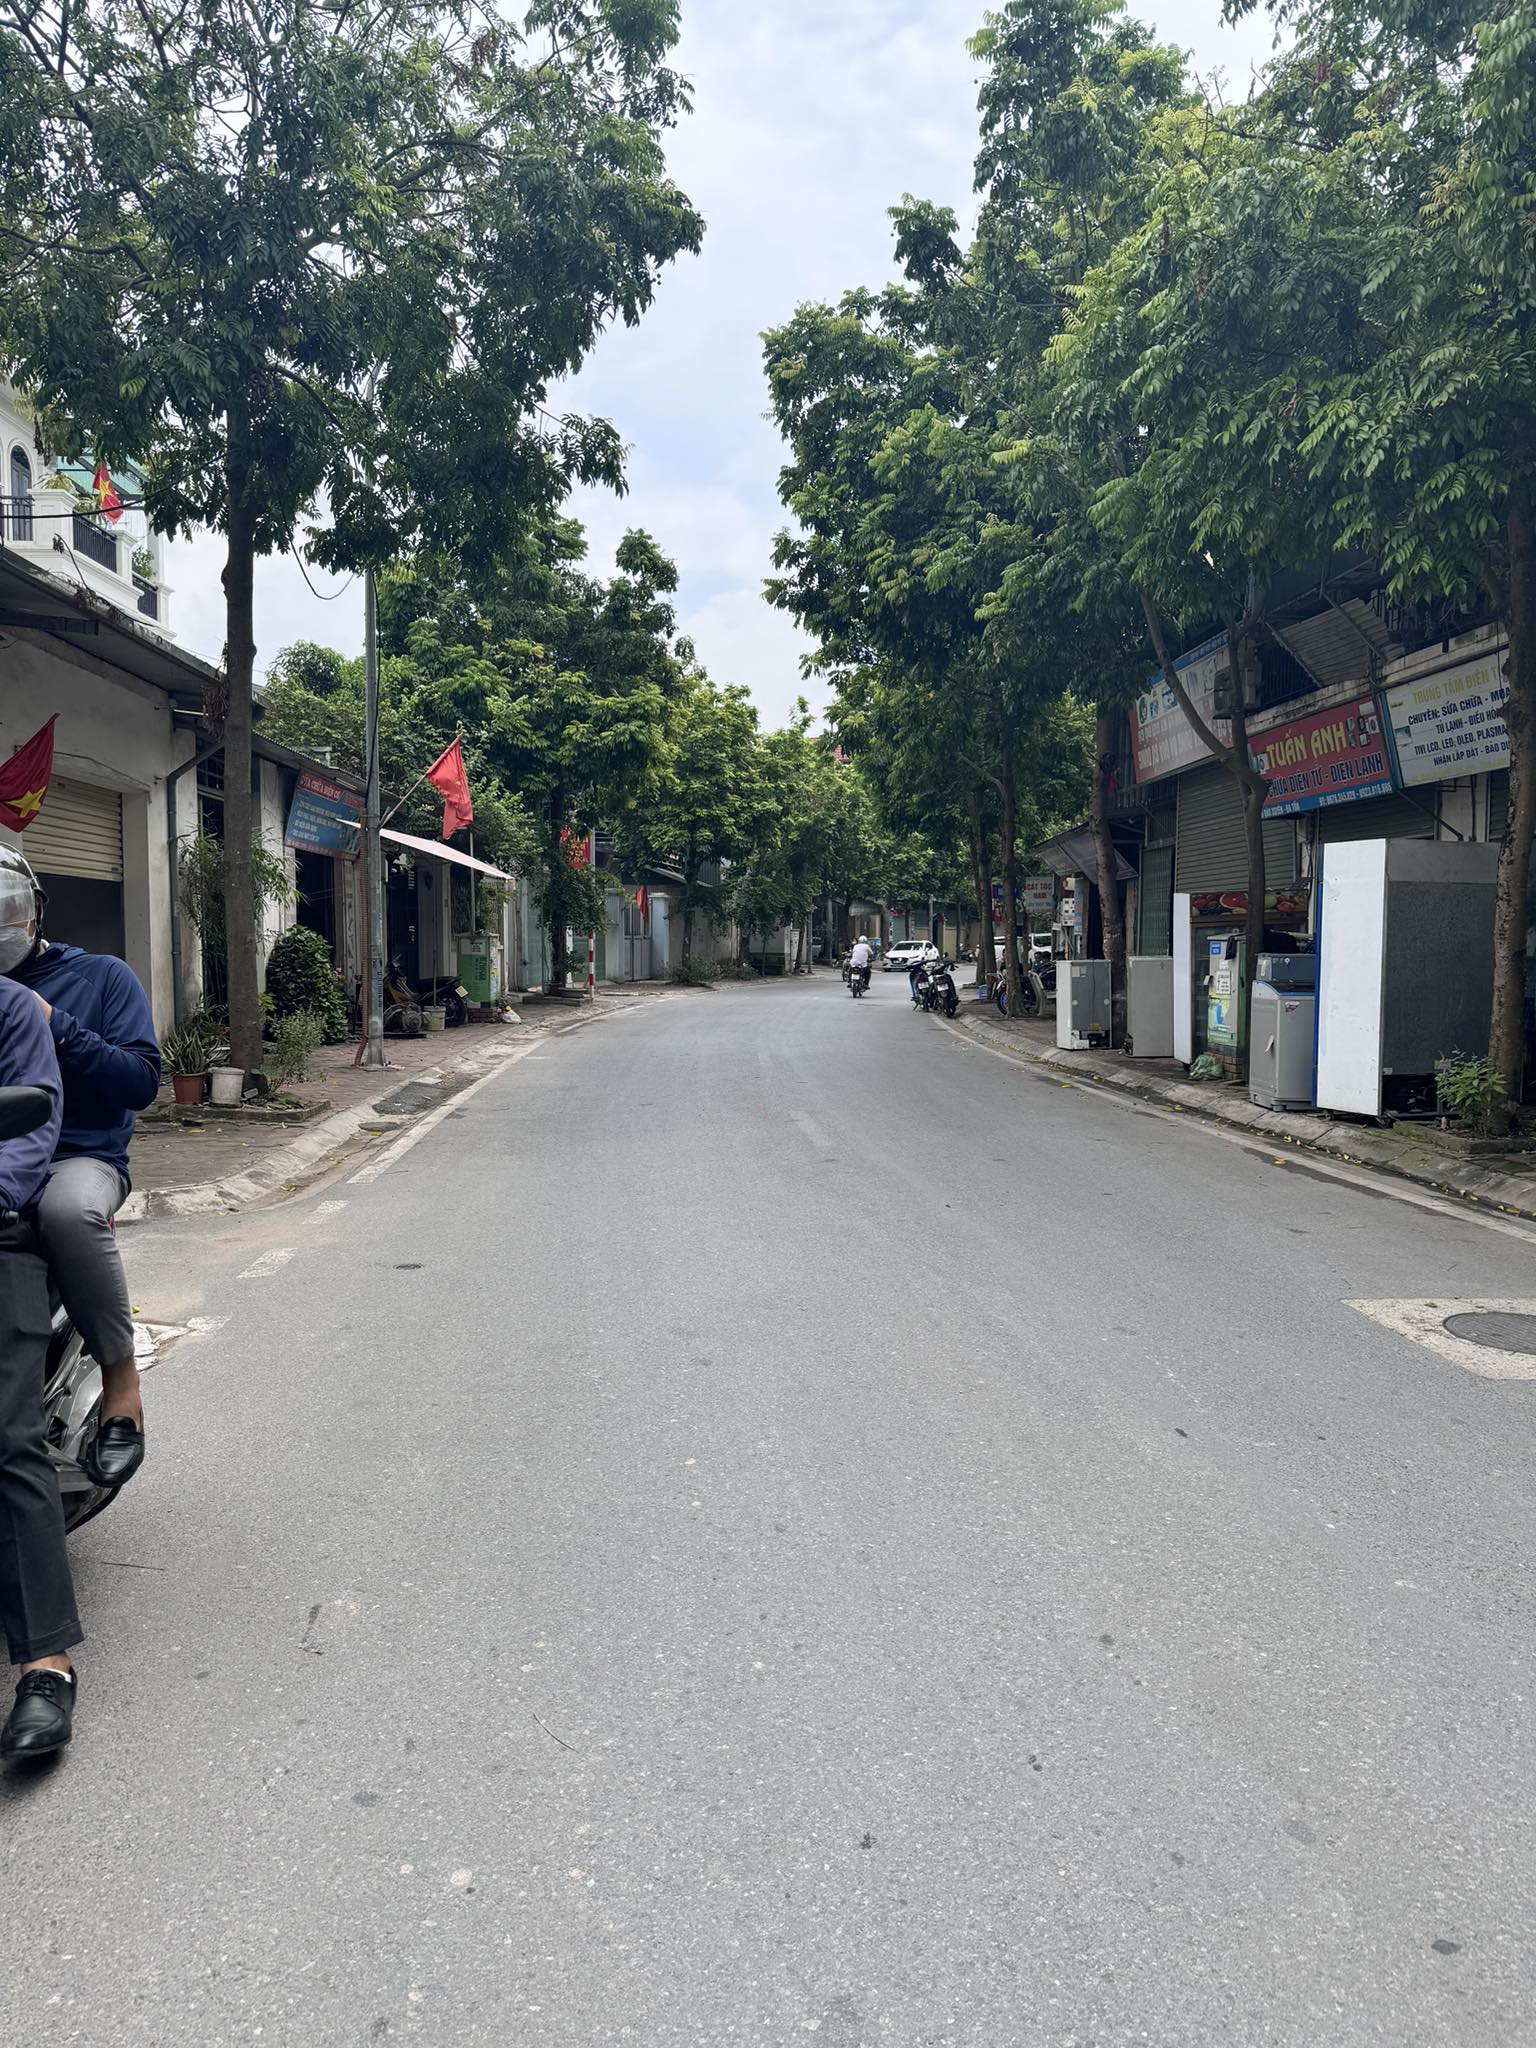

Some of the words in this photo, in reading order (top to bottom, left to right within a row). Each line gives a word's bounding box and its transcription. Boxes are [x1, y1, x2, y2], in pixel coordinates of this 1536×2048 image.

[1413, 686, 1441, 705] TRUNG
[1443, 678, 1464, 697] TÂM
[1465, 669, 1490, 690] ĐIỆN
[1446, 718, 1464, 734] LẠNH
[1266, 727, 1308, 769] TUẤN
[1310, 721, 1347, 759] ANH
[1414, 745, 1426, 756] TIVI
[1433, 753, 1452, 767] NHẬN
[1485, 740, 1499, 754] BẢO
[1289, 768, 1310, 796] ĐIỆN
[1330, 756, 1354, 786] ĐIỆN
[1355, 752, 1384, 781] LẠNH
